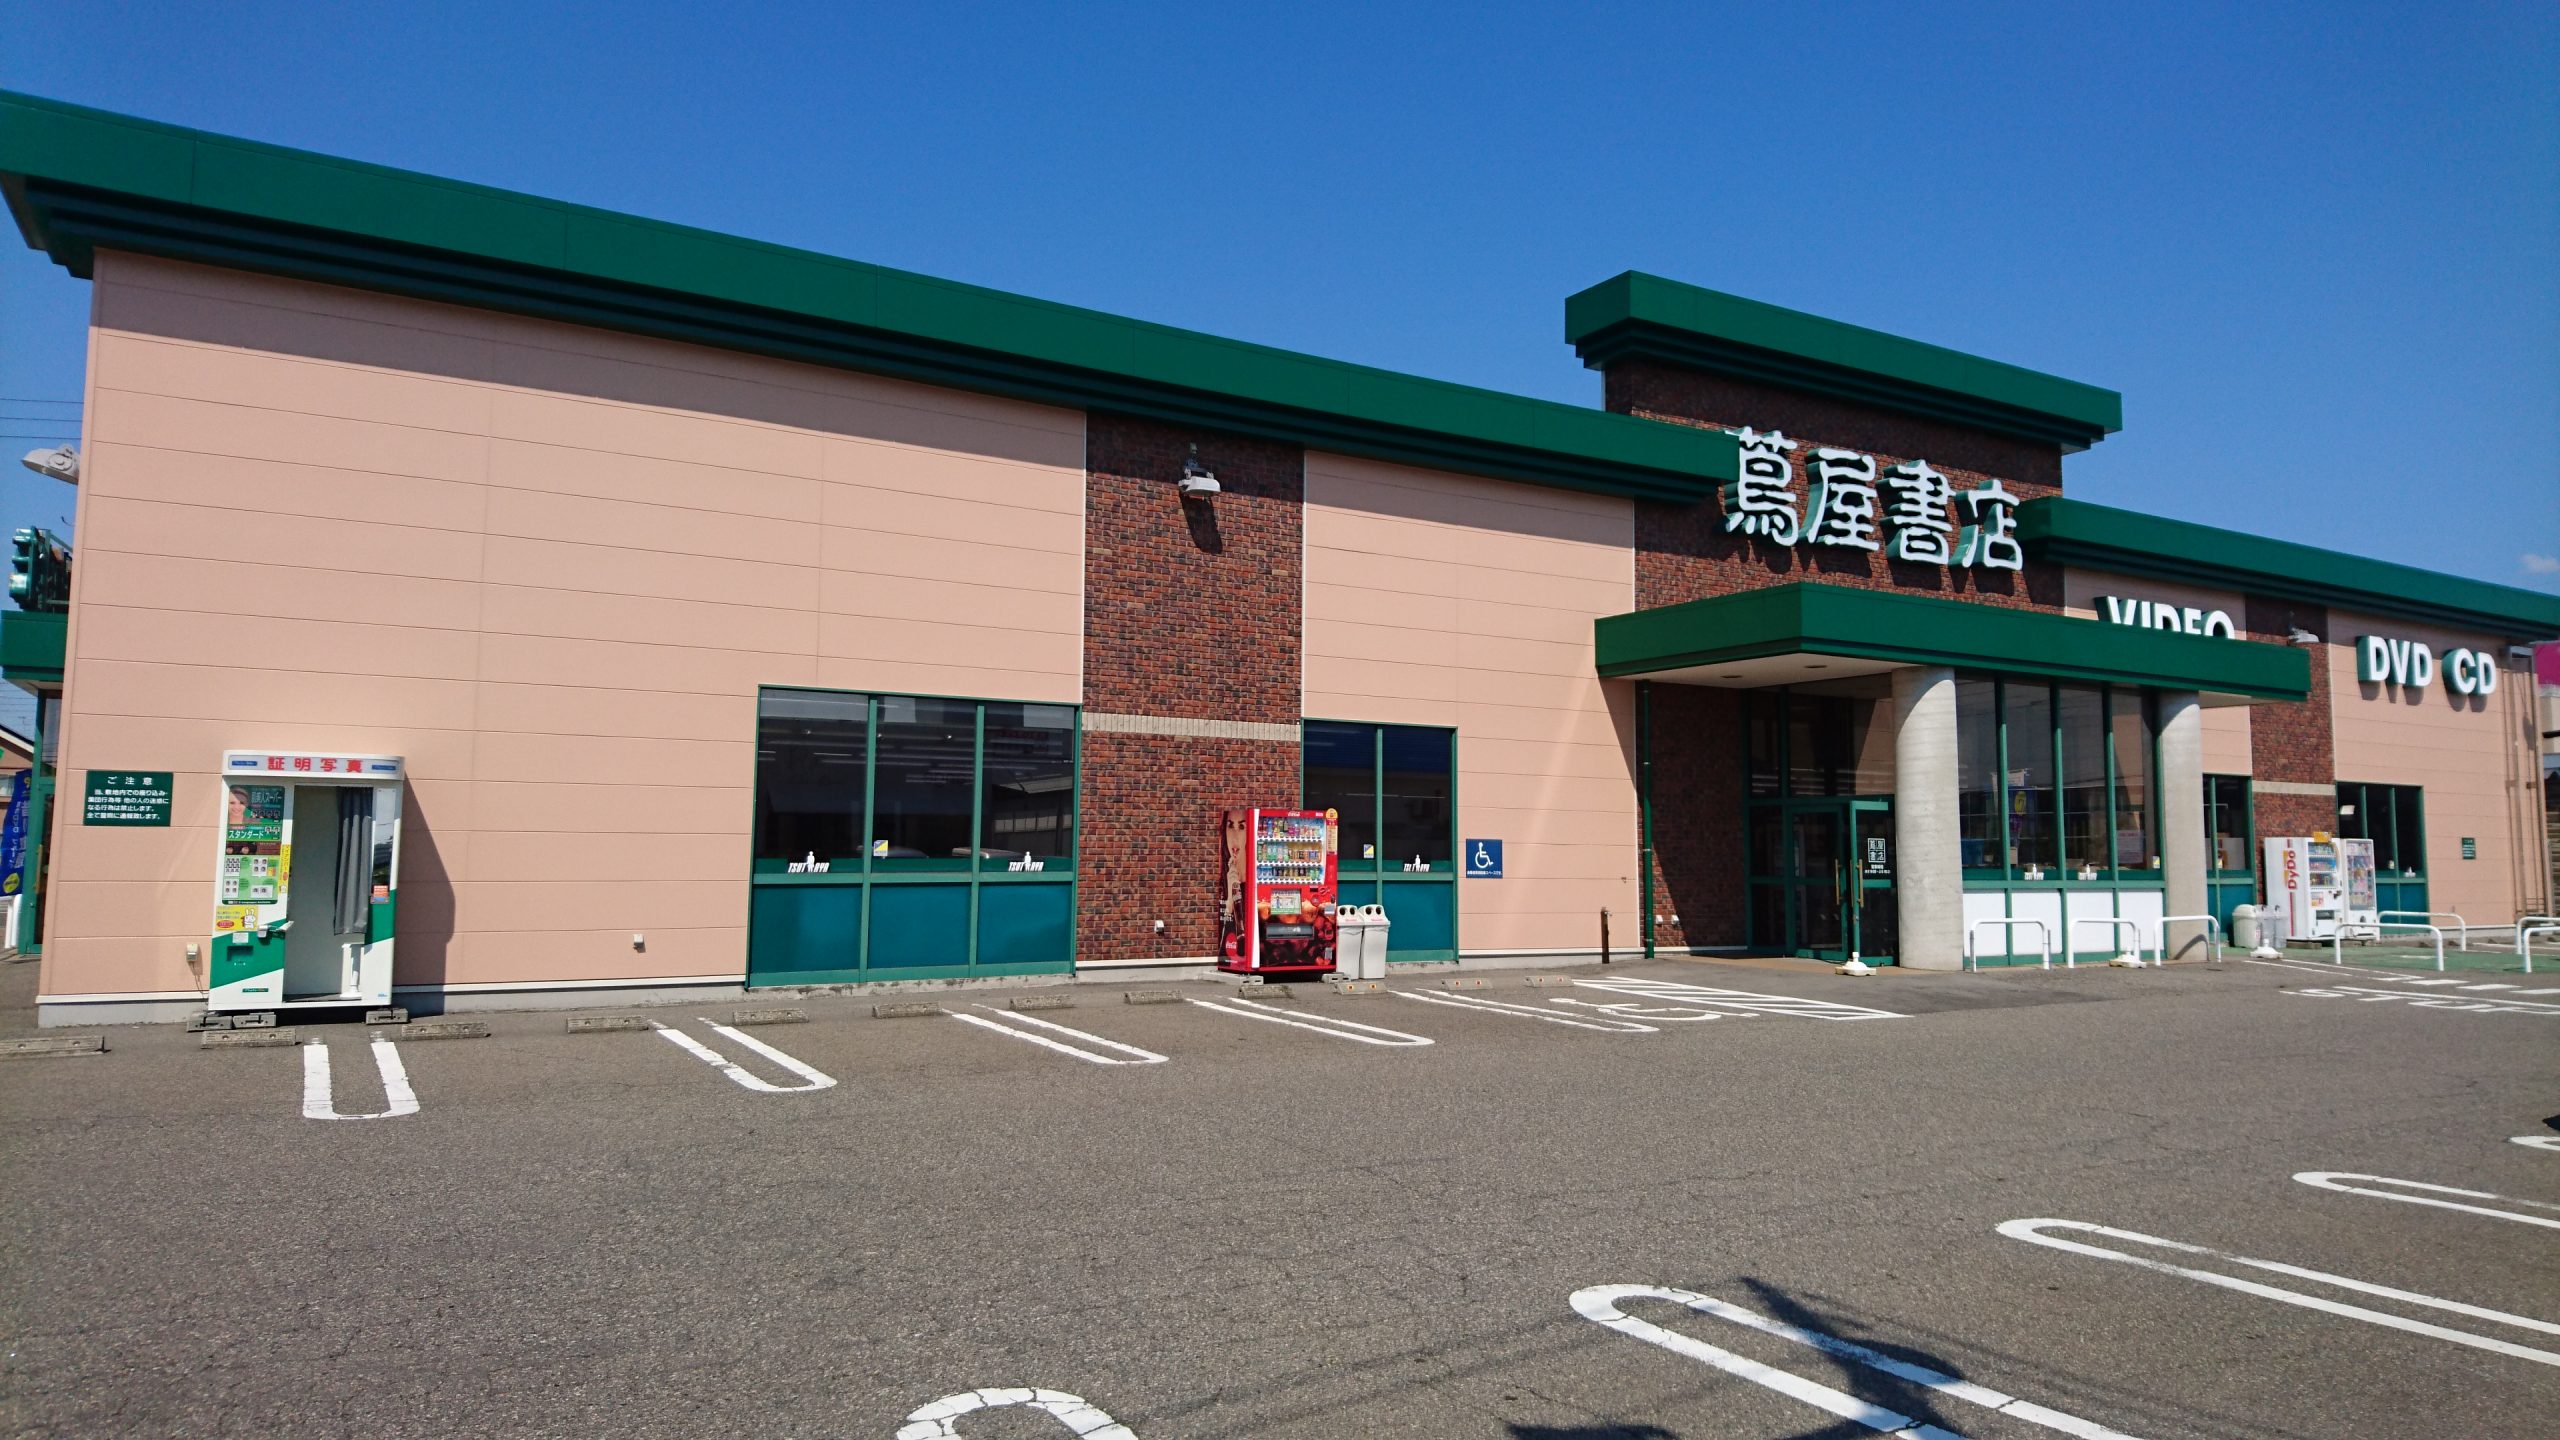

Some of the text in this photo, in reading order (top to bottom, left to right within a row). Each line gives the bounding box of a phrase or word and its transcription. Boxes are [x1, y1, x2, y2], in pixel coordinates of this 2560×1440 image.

[2369, 635, 2497, 696] DVD CD
[267, 756, 363, 773] 証明写真
[228, 830, 264, 839] スタンダード
[2287, 850, 2300, 890] DyDo
